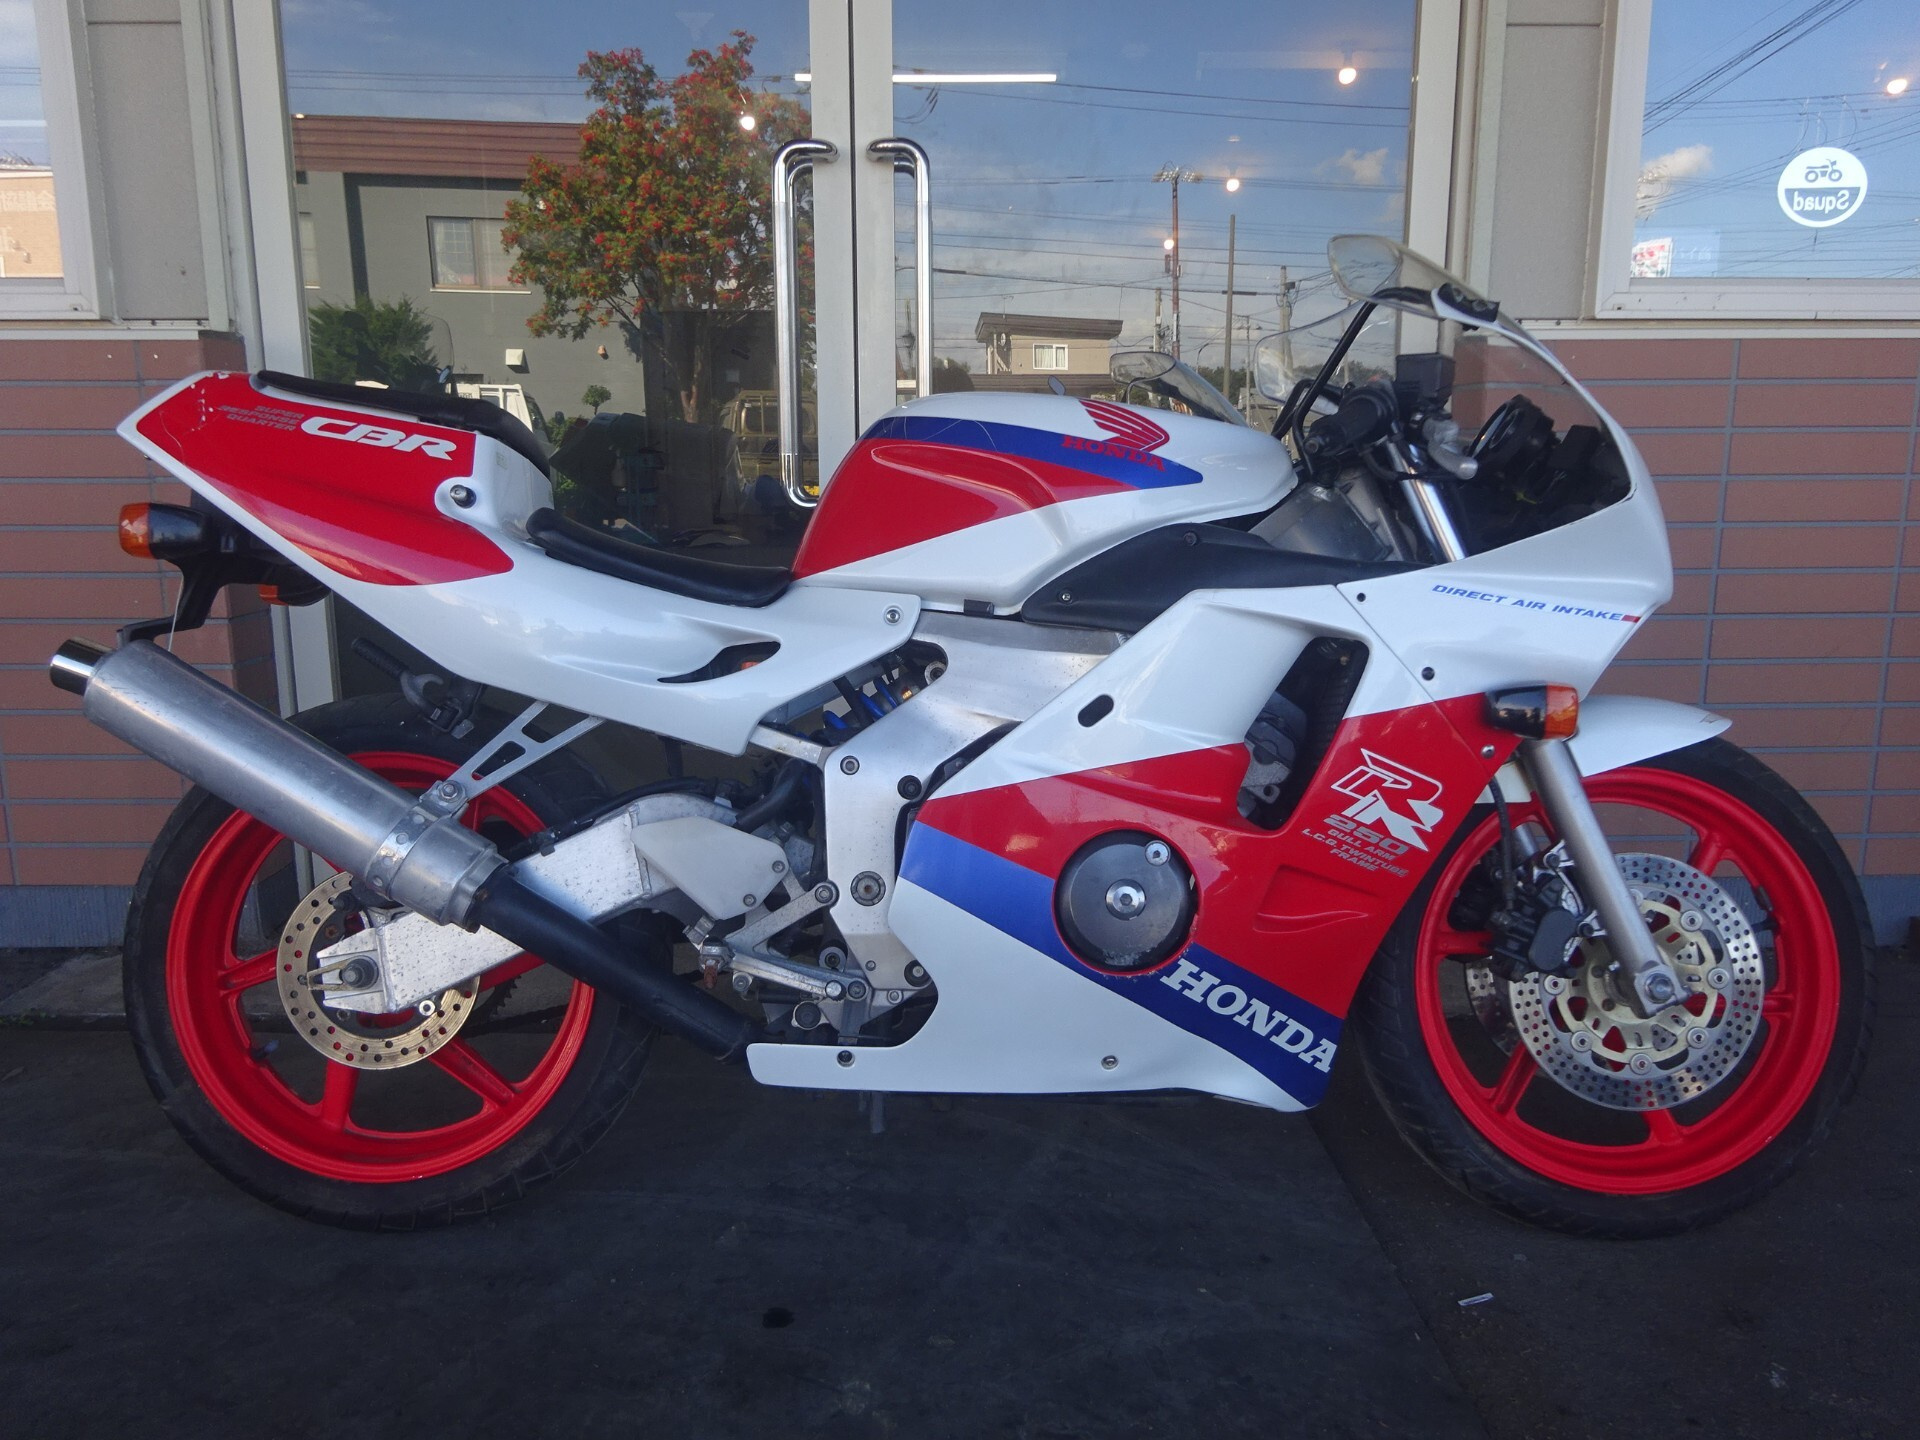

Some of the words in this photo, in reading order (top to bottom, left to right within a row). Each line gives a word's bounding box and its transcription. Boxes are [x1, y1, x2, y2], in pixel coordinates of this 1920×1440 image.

[226, 413, 297, 431] QUARTER
[254, 405, 305, 420] SUPER
[301, 416, 457, 461] CBR
[1061, 434, 1166, 472] HONDA
[1432, 584, 1508, 603] DIRECT
[1512, 599, 1547, 611] AIR
[1552, 604, 1623, 622] INTAKE
[1323, 814, 1409, 855] 250
[1327, 828, 1362, 848] GULL
[1364, 845, 1397, 861] ARM
[1329, 848, 1379, 872] FRAME
[1340, 843, 1409, 878] TWINTUBE
[1159, 958, 1338, 1073] HONDA
